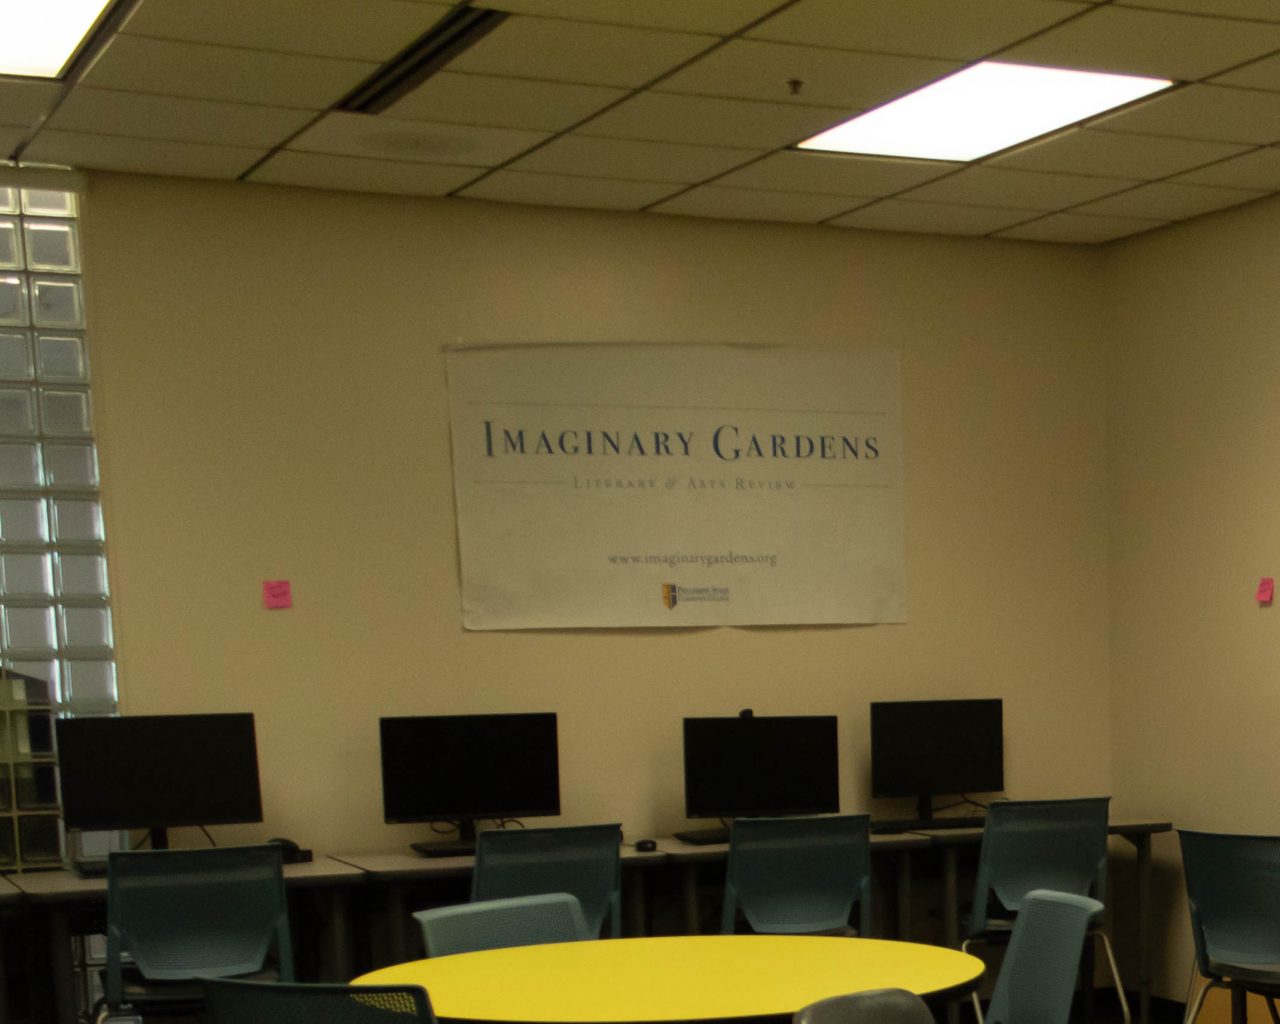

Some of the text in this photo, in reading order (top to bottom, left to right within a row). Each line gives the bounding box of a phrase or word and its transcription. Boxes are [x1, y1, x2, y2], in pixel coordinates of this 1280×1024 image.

[482, 420, 881, 461] IMAGINARY GARDENS
[687, 476, 726, 490] ARTS
[734, 476, 796, 490] REVIEW
[607, 550, 777, 568] www.imaginarygardens.org
